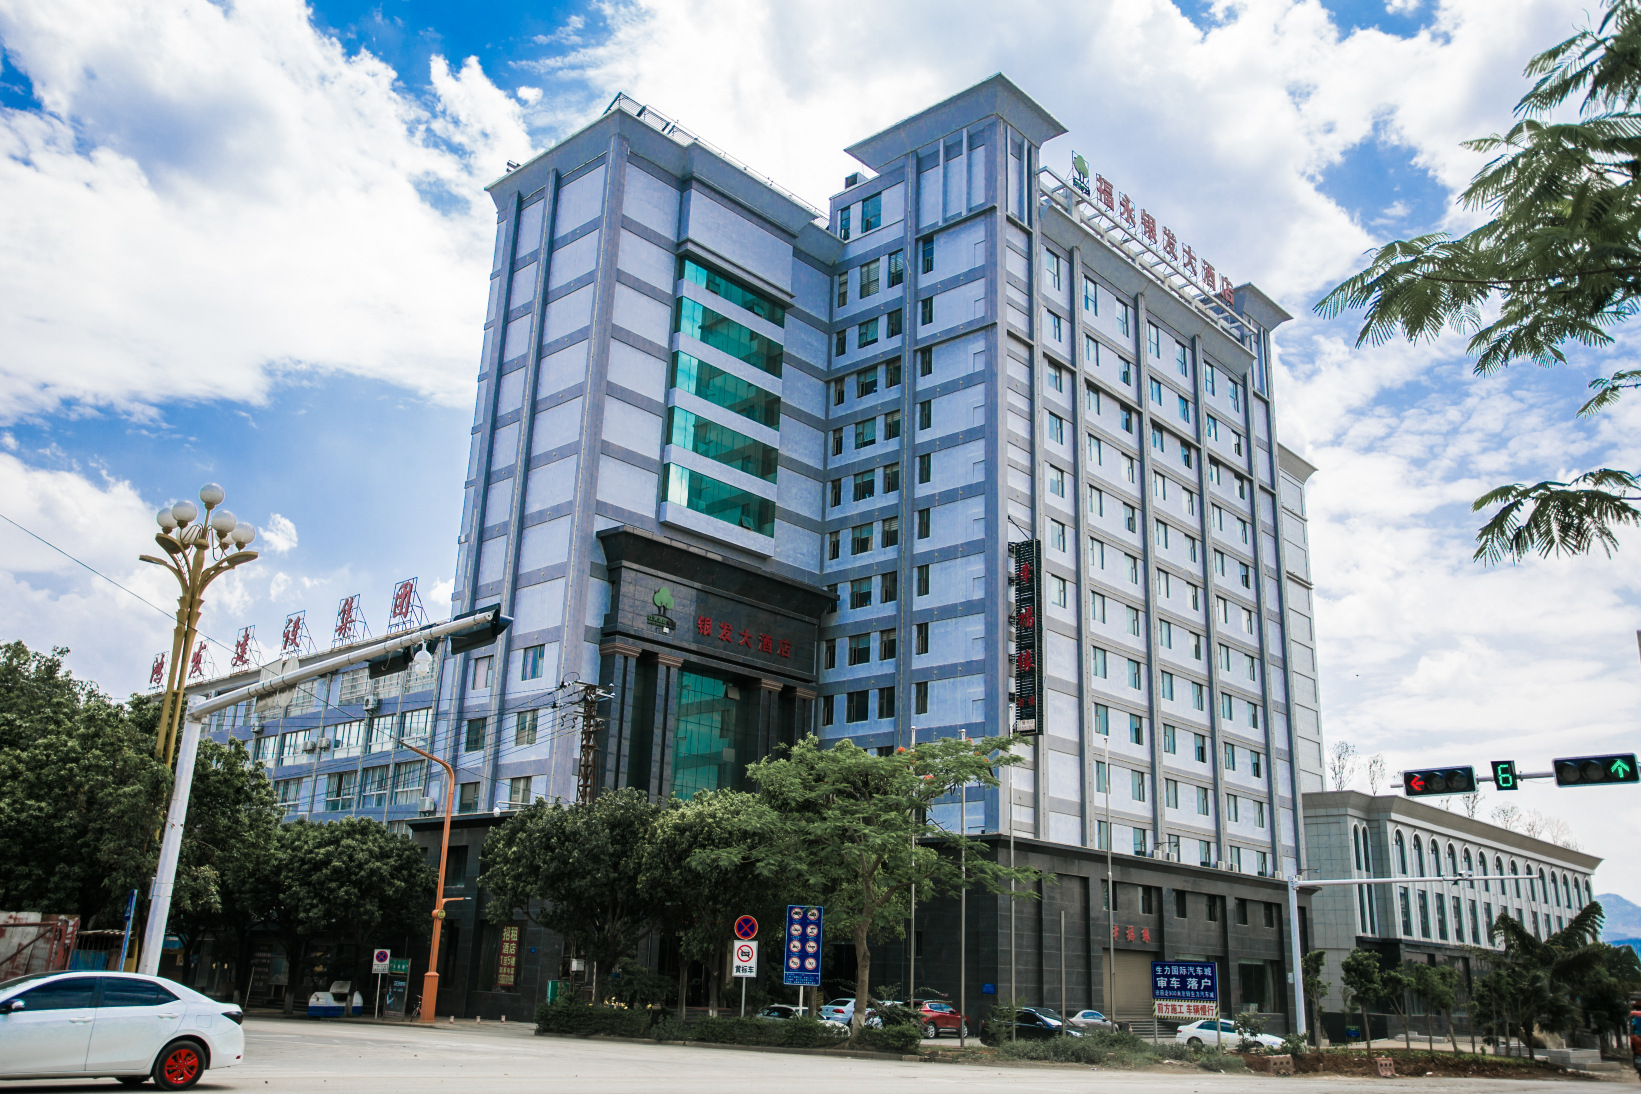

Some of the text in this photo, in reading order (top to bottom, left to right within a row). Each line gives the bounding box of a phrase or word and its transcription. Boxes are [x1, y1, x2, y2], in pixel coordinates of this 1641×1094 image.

[1097, 174, 1234, 306] 福永银发大酒店
[1017, 562, 1035, 672] 幸福缘
[150, 581, 413, 684] 鸿发建设集团
[697, 615, 791, 658] 银发大酒店
[1497, 764, 1513, 787] 6
[503, 926, 518, 941] 招租
[502, 943, 516, 954] 酒店
[735, 965, 754, 974] 黄标车
[1155, 965, 1212, 976] 生力国际汽车城
[1156, 977, 1211, 990] 审车 落户
[1157, 1003, 1214, 1016] 前方施工 车辆慢行
